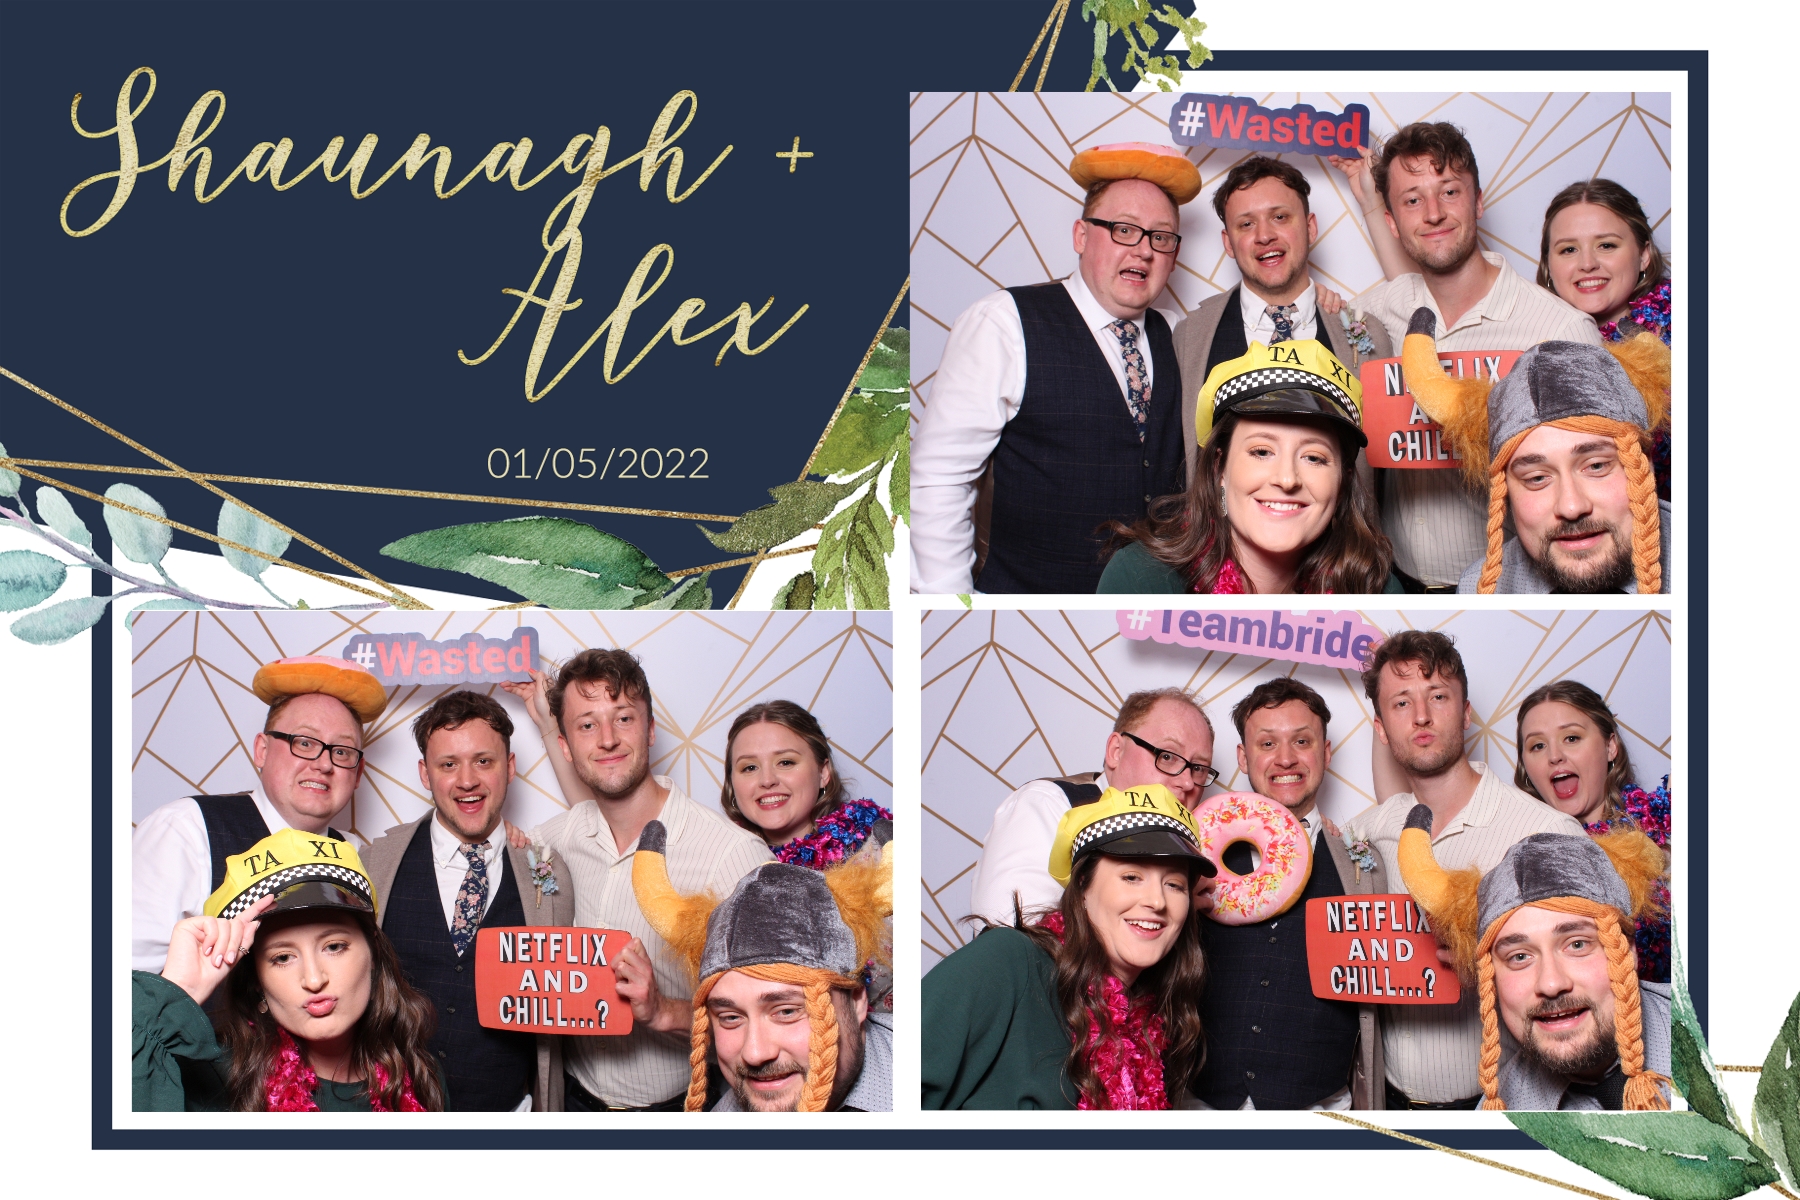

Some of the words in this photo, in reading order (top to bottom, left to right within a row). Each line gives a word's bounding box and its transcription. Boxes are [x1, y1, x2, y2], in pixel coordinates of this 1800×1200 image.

[1178, 101, 1362, 149] #Wasted
[351, 635, 531, 677] #Wasted
[1326, 900, 1432, 933] NETFLIX
[499, 931, 608, 966] NETFLIX
[1347, 938, 1414, 962] AND
[518, 969, 589, 993] AND
[1330, 965, 1437, 998] CHILL...?
[499, 995, 610, 1029] CHILL...?
